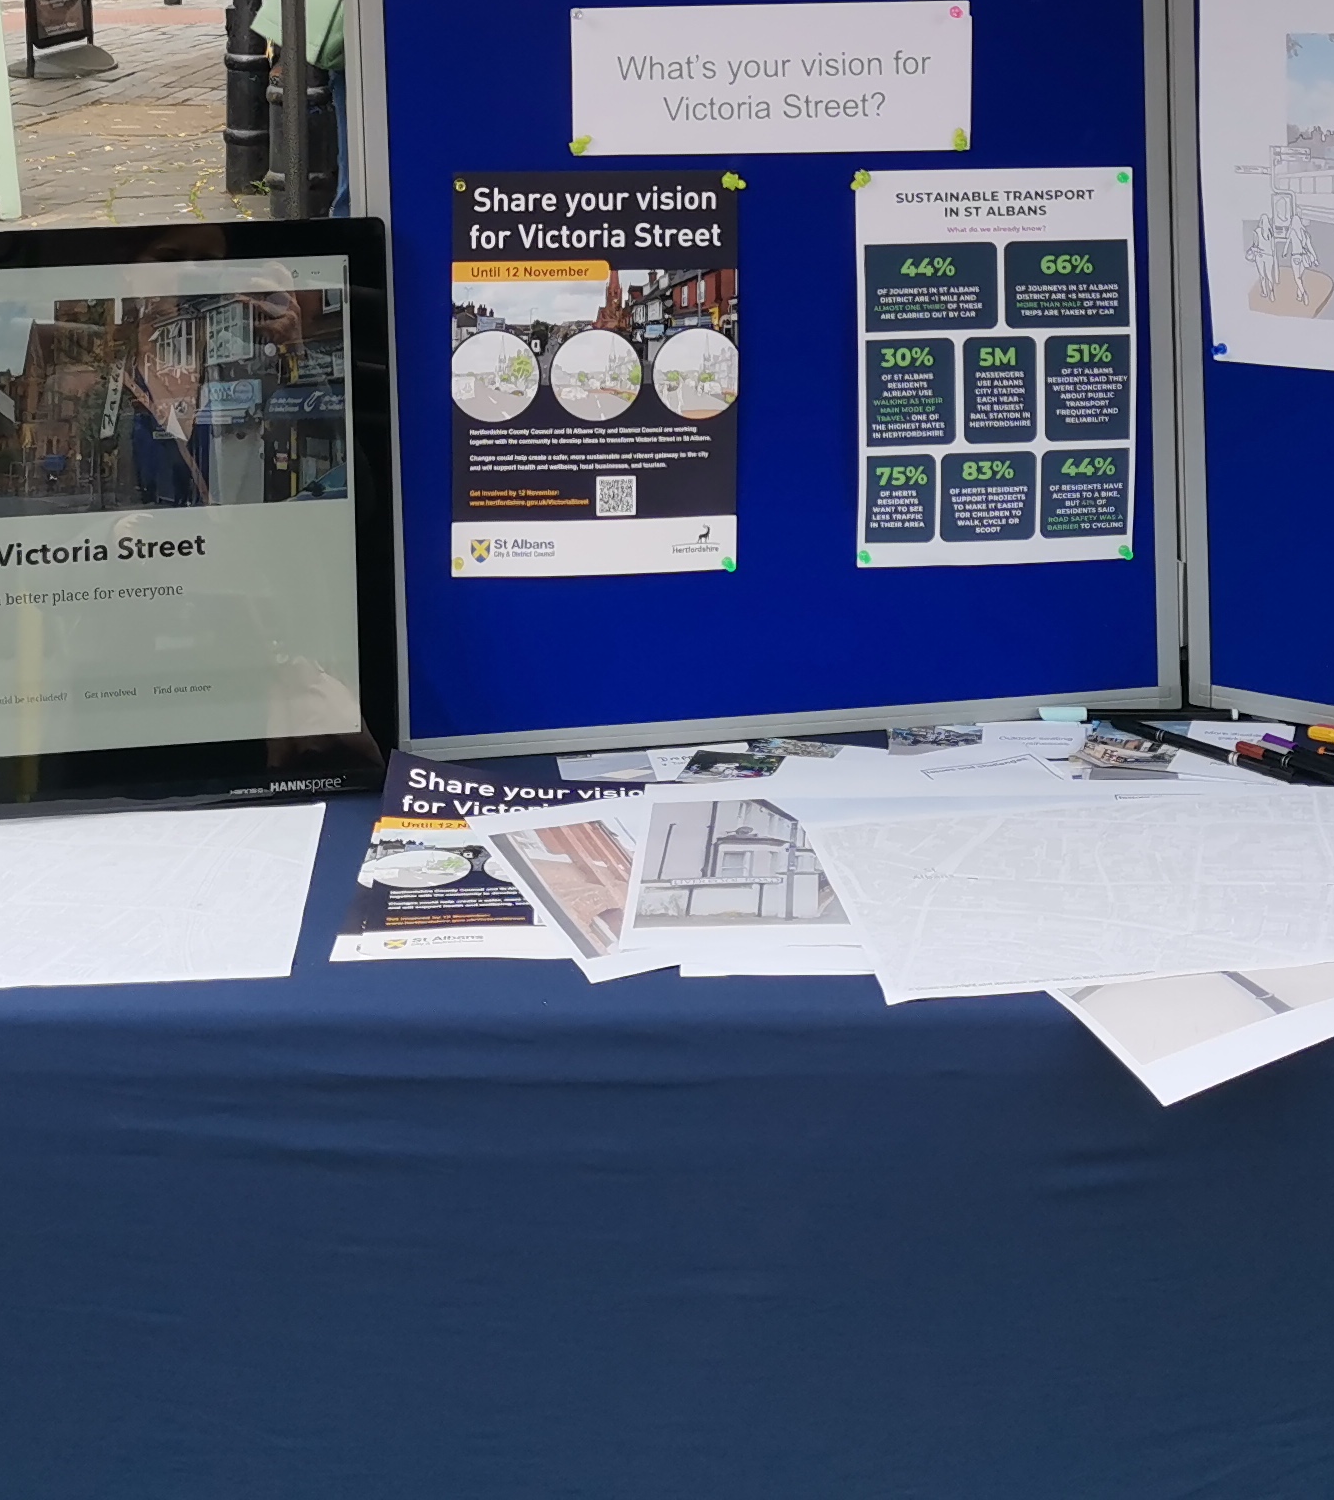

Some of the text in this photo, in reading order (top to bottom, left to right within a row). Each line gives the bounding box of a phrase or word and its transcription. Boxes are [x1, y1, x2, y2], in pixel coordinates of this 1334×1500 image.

[617, 50, 932, 85] What's your vision for
[663, 92, 886, 122] Victoria Street?
[473, 185, 717, 218] Share your vision
[895, 189, 1095, 204] SUSTAINABLE TRANSPORT
[944, 205, 1047, 217] IN ST ALBANS
[470, 223, 721, 250] for Victoria Street
[993, 225, 1020, 234] already
[1022, 225, 1046, 233] know?
[471, 265, 589, 278] Until 12 November
[900, 257, 956, 277] 44%
[1040, 254, 1093, 275] 66%
[880, 296, 913, 304] DISTRICT
[889, 287, 927, 295] JOURNEYS
[880, 347, 934, 368] 30%
[979, 346, 1016, 367] 5M
[1066, 343, 1112, 364] 51%
[875, 466, 928, 486] 75%
[962, 460, 1014, 480] 83%
[1061, 457, 1115, 477] 44%
[117, 535, 206, 560] Street
[494, 538, 555, 550] St Albans
[672, 545, 720, 554] Hertfordshire
[494, 550, 504, 558] City
[6, 592, 49, 606] better
[52, 589, 90, 607] place
[94, 587, 115, 600] for
[118, 583, 184, 601] everyone
[15, 694, 25, 704] be
[27, 692, 67, 704] included?
[85, 687, 137, 700] Get involved
[153, 684, 212, 695] Find out more
[270, 777, 342, 794] HANNspree
[408, 768, 495, 798] Share
[503, 786, 570, 801] your
[402, 795, 445, 814] for
[401, 820, 455, 830] Until 12
[432, 935, 484, 943] Albans
